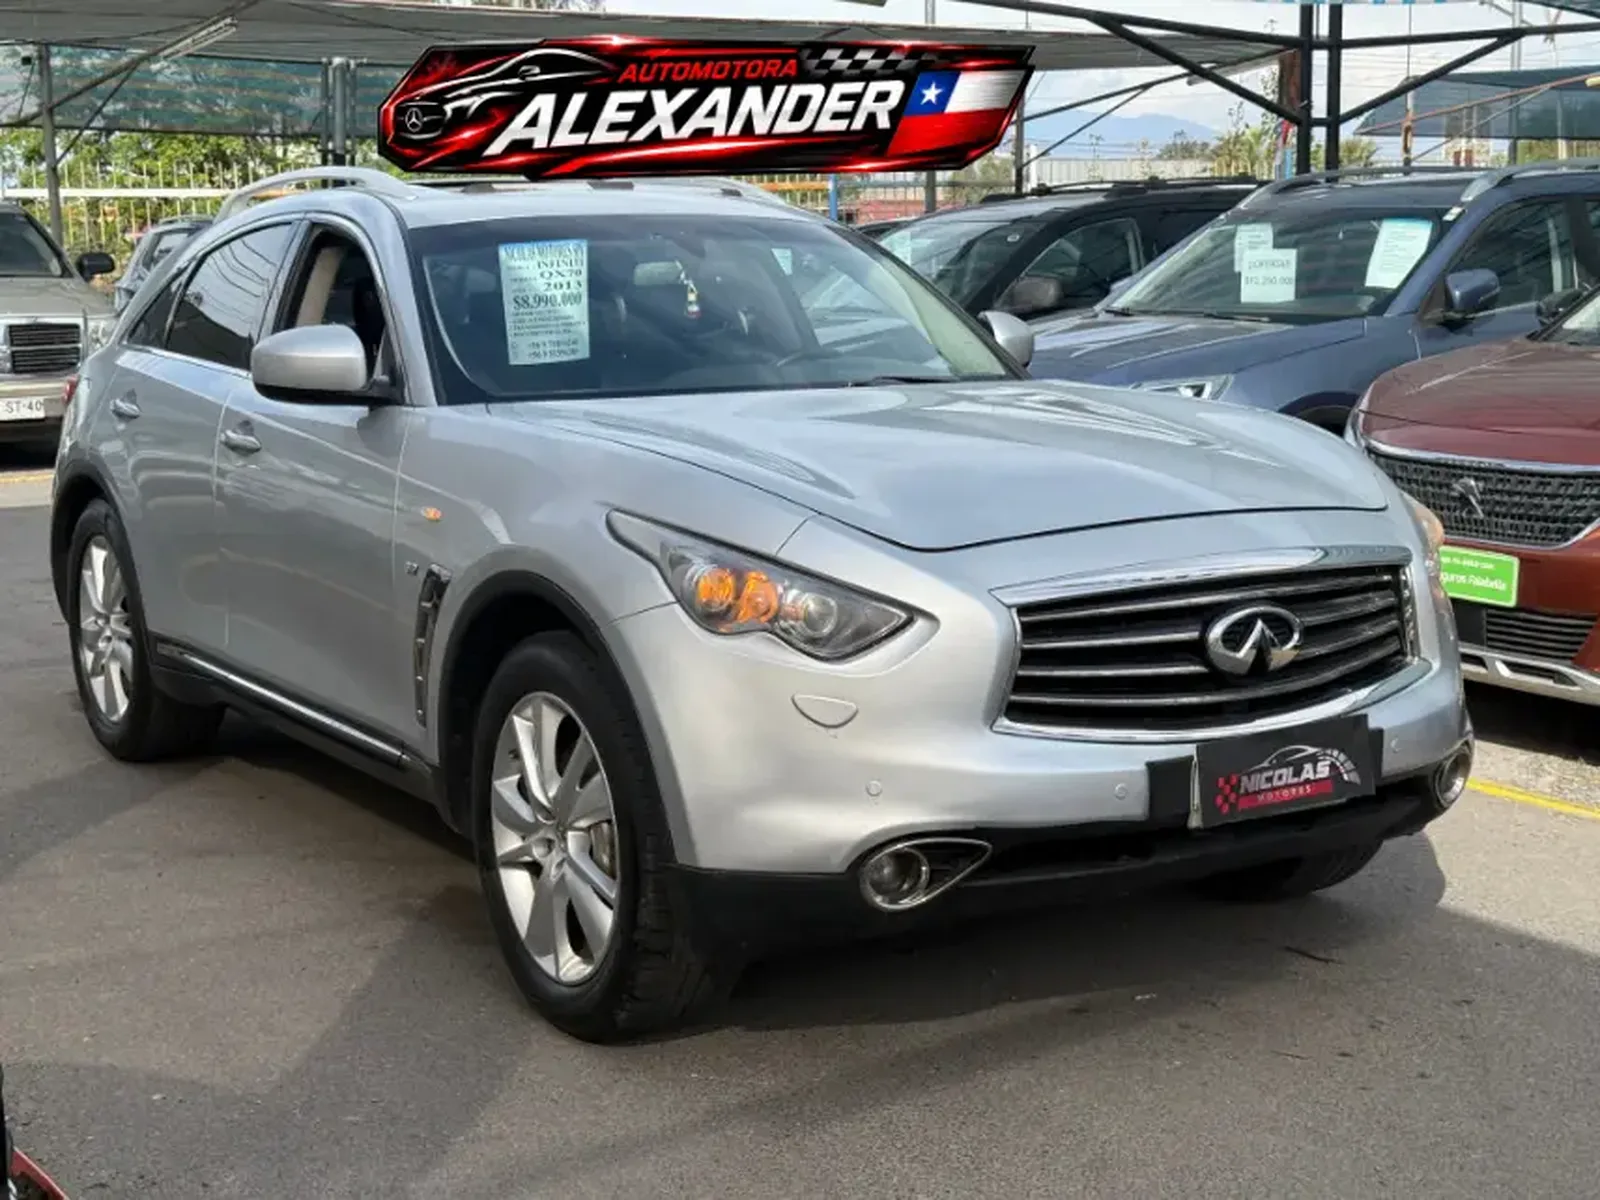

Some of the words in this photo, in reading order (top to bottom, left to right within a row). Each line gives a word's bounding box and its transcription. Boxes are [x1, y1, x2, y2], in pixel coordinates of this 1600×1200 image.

[537, 258, 583, 268] INFINITI
[539, 269, 582, 280] QX70
[513, 292, 582, 310] $8.990.000
[1238, 760, 1332, 794] NICOLAS
[1257, 784, 1312, 802] MOTORES
